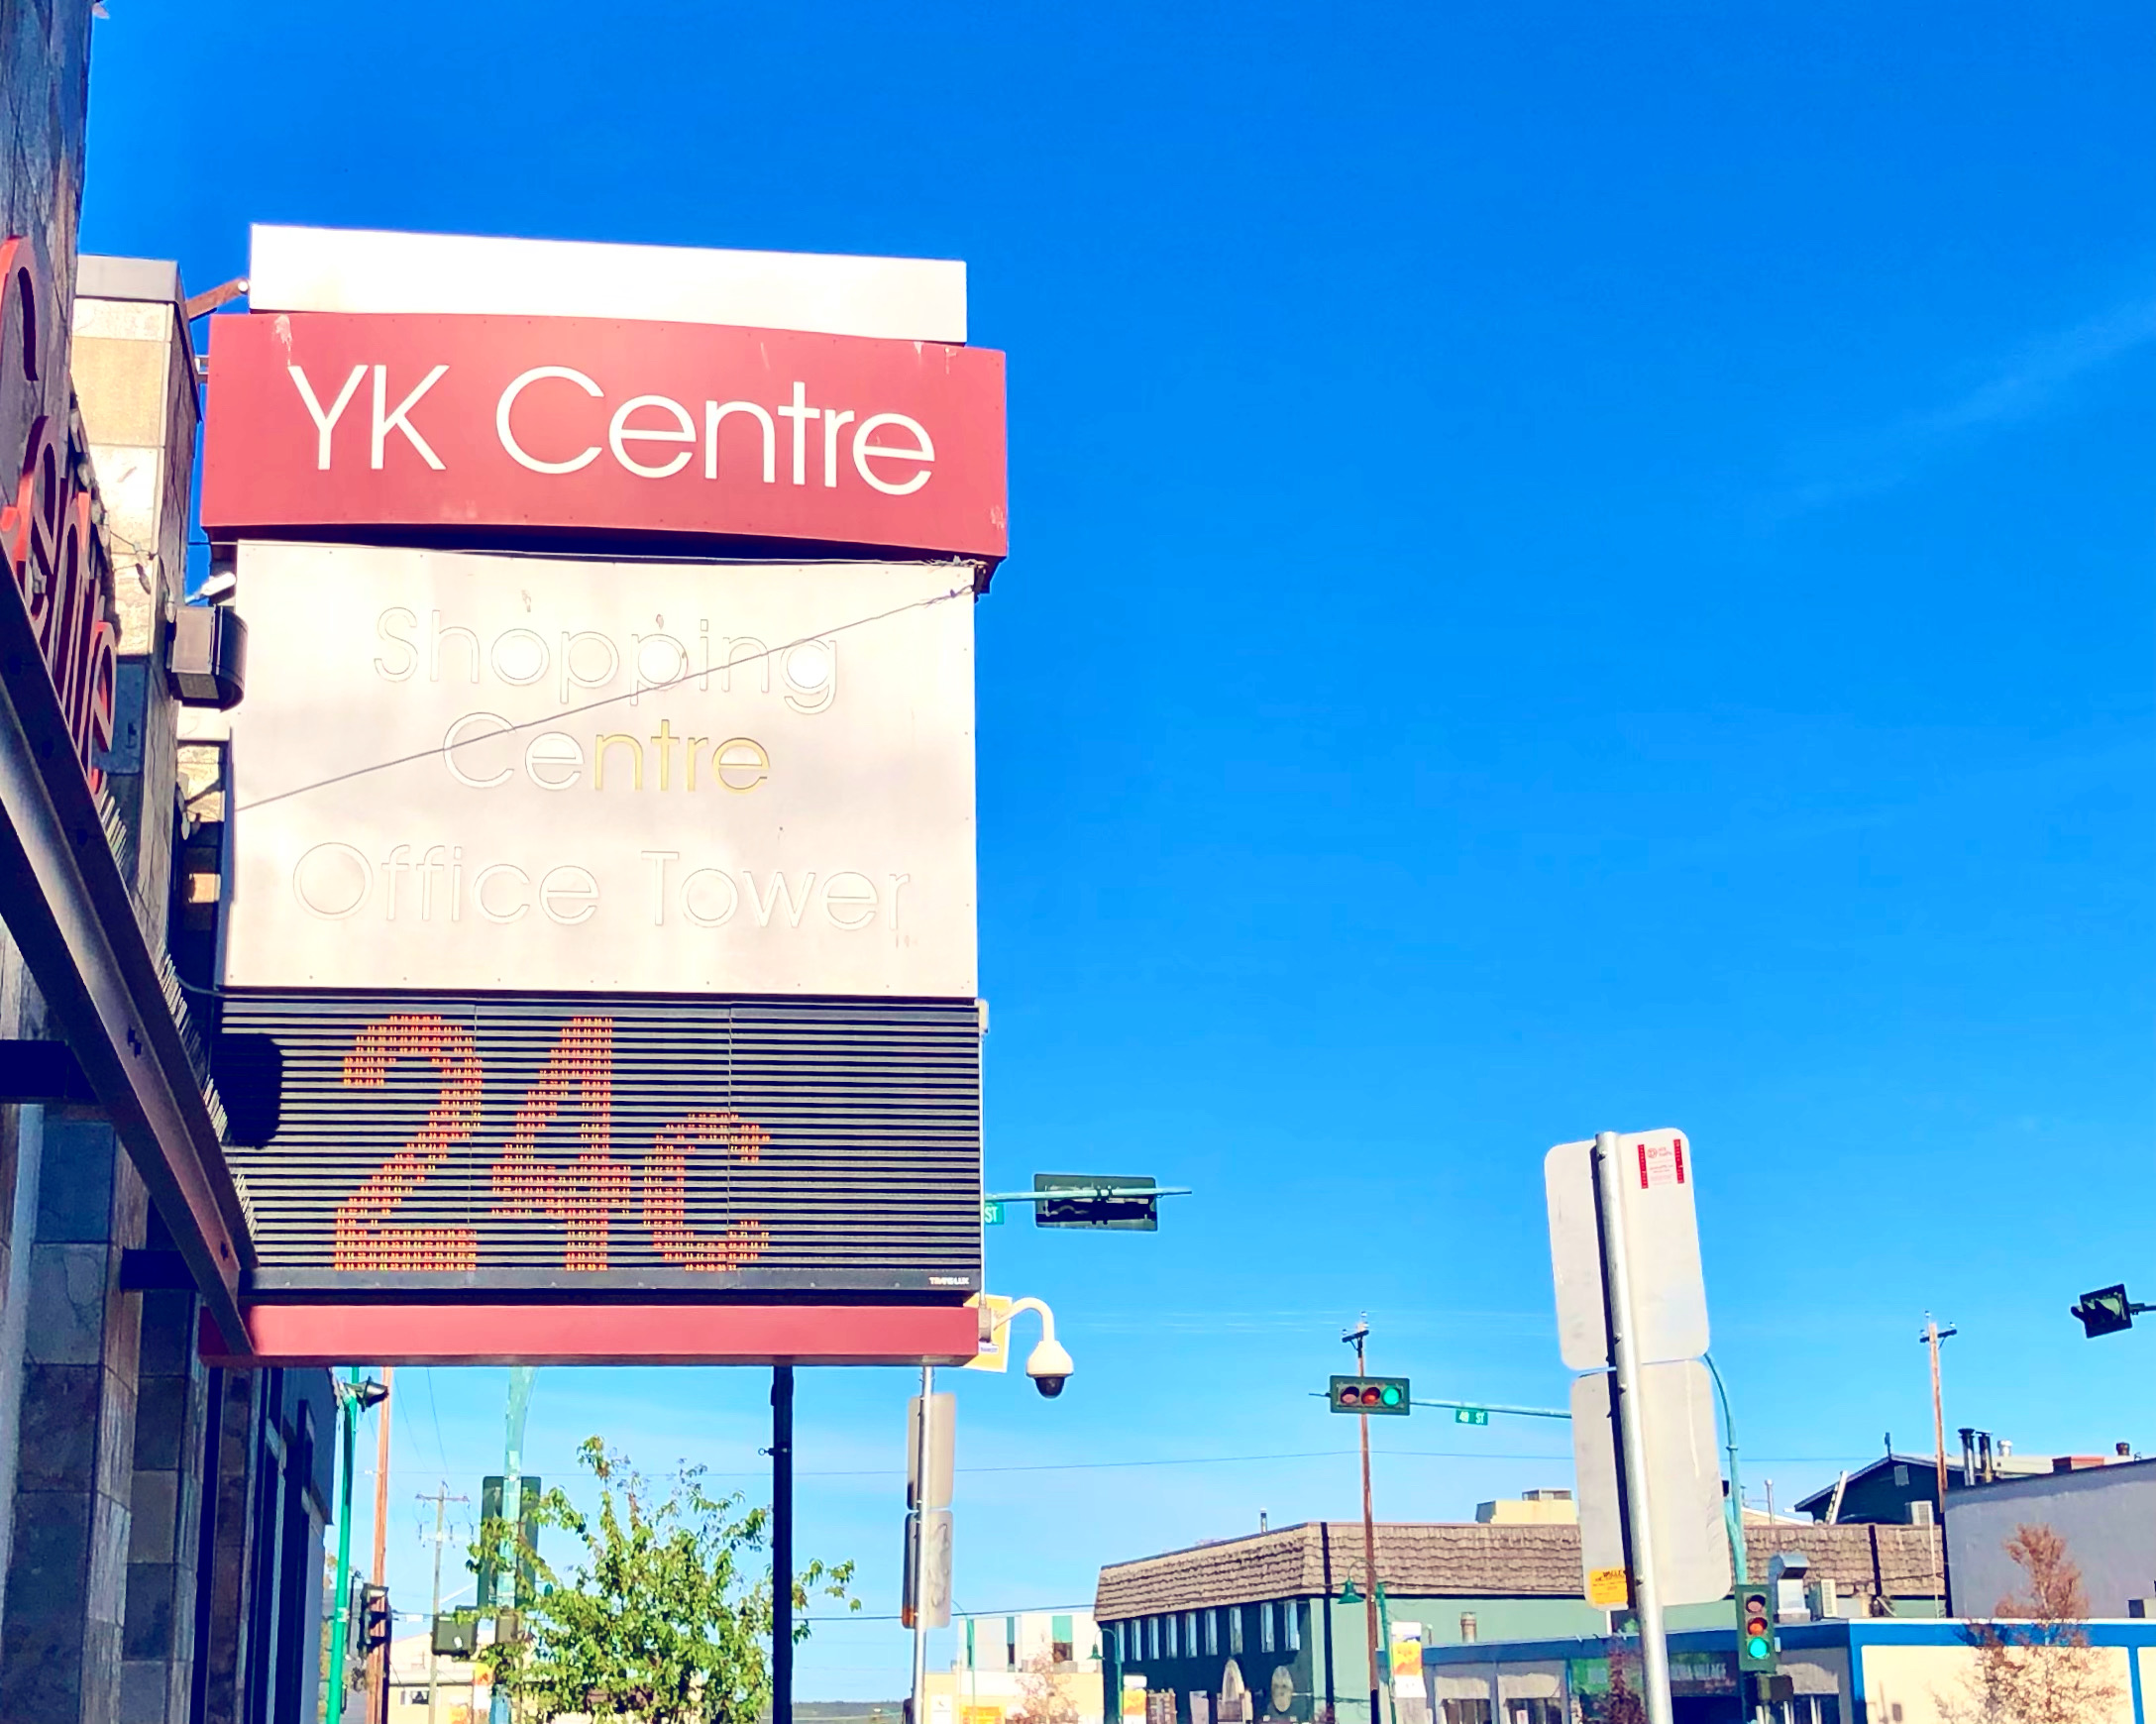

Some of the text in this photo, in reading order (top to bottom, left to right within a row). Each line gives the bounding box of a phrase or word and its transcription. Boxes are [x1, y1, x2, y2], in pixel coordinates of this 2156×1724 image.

[288, 364, 936, 495] YK Centre
[374, 606, 838, 714] Shopping
[443, 711, 771, 795] Centre
[292, 841, 911, 930] Office Tower
[984, 1206, 998, 1224] ST
[1475, 1412, 1485, 1424] ST
